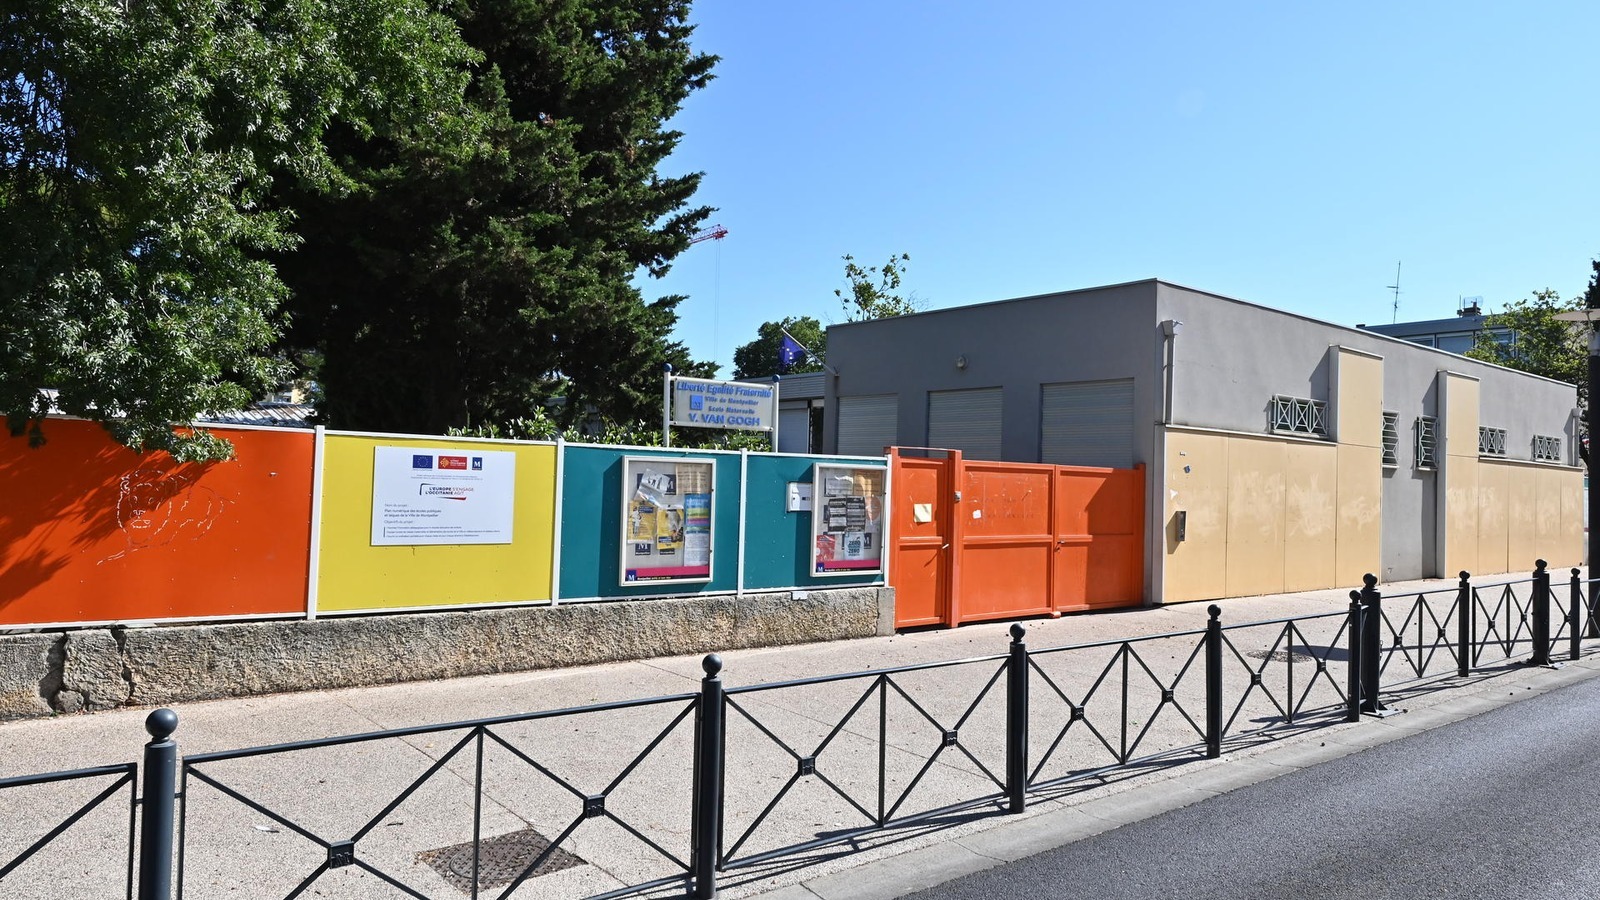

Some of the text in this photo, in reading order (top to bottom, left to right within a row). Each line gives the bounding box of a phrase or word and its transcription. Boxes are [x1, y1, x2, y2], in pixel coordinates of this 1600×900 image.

[677, 381, 772, 398] Liberté Egalité Fraternité
[728, 398, 759, 406] Montpellier
[708, 405, 755, 415] Ecole Maternelle
[688, 413, 760, 426] V. VAN GOGH
